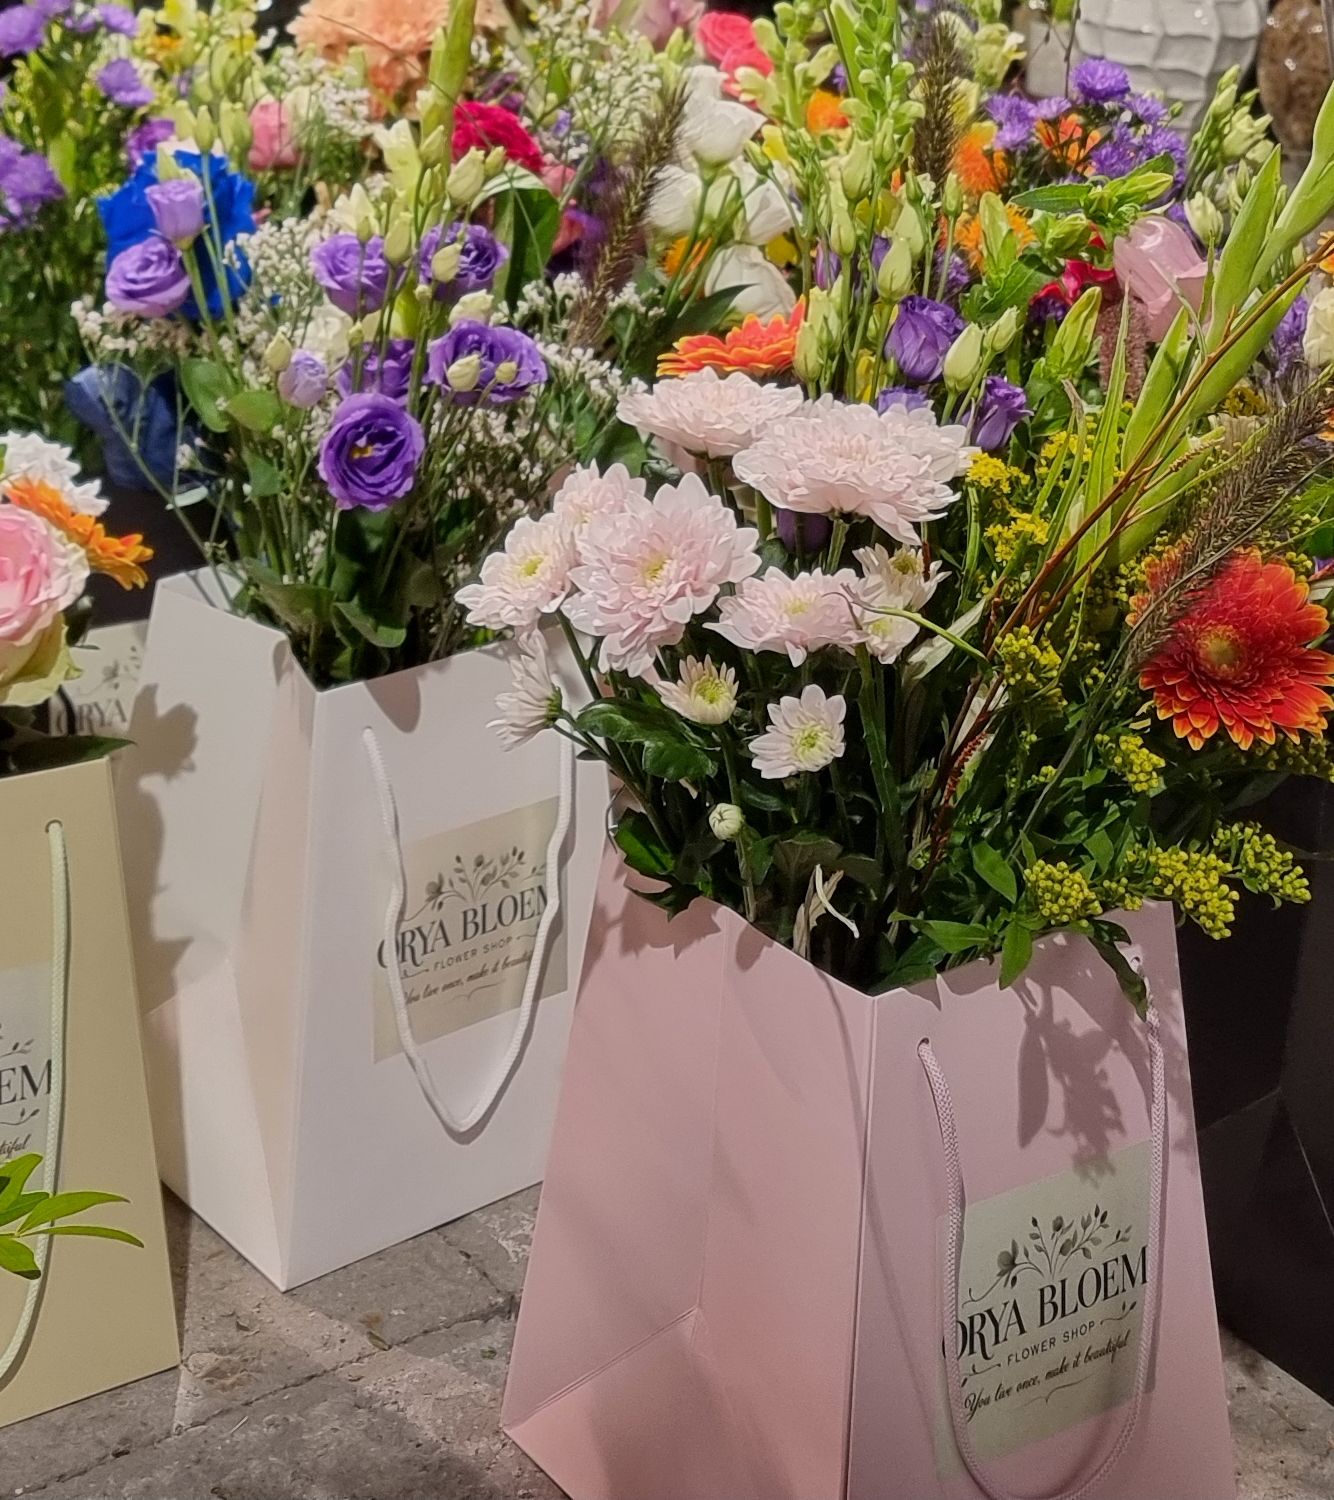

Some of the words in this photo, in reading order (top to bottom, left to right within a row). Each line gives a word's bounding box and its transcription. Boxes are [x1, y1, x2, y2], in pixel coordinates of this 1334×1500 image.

[482, 936, 513, 954] SHOP
[1038, 1244, 1148, 1329] BLOEM
[1007, 1336, 1056, 1366] FLOWER
[1062, 1320, 1095, 1343] SHOP
[963, 1387, 991, 1423] You
[994, 1382, 1013, 1402] live
[1044, 1356, 1070, 1380] make
[1072, 1351, 1082, 1369] it
[1083, 1329, 1131, 1364] beautiful
